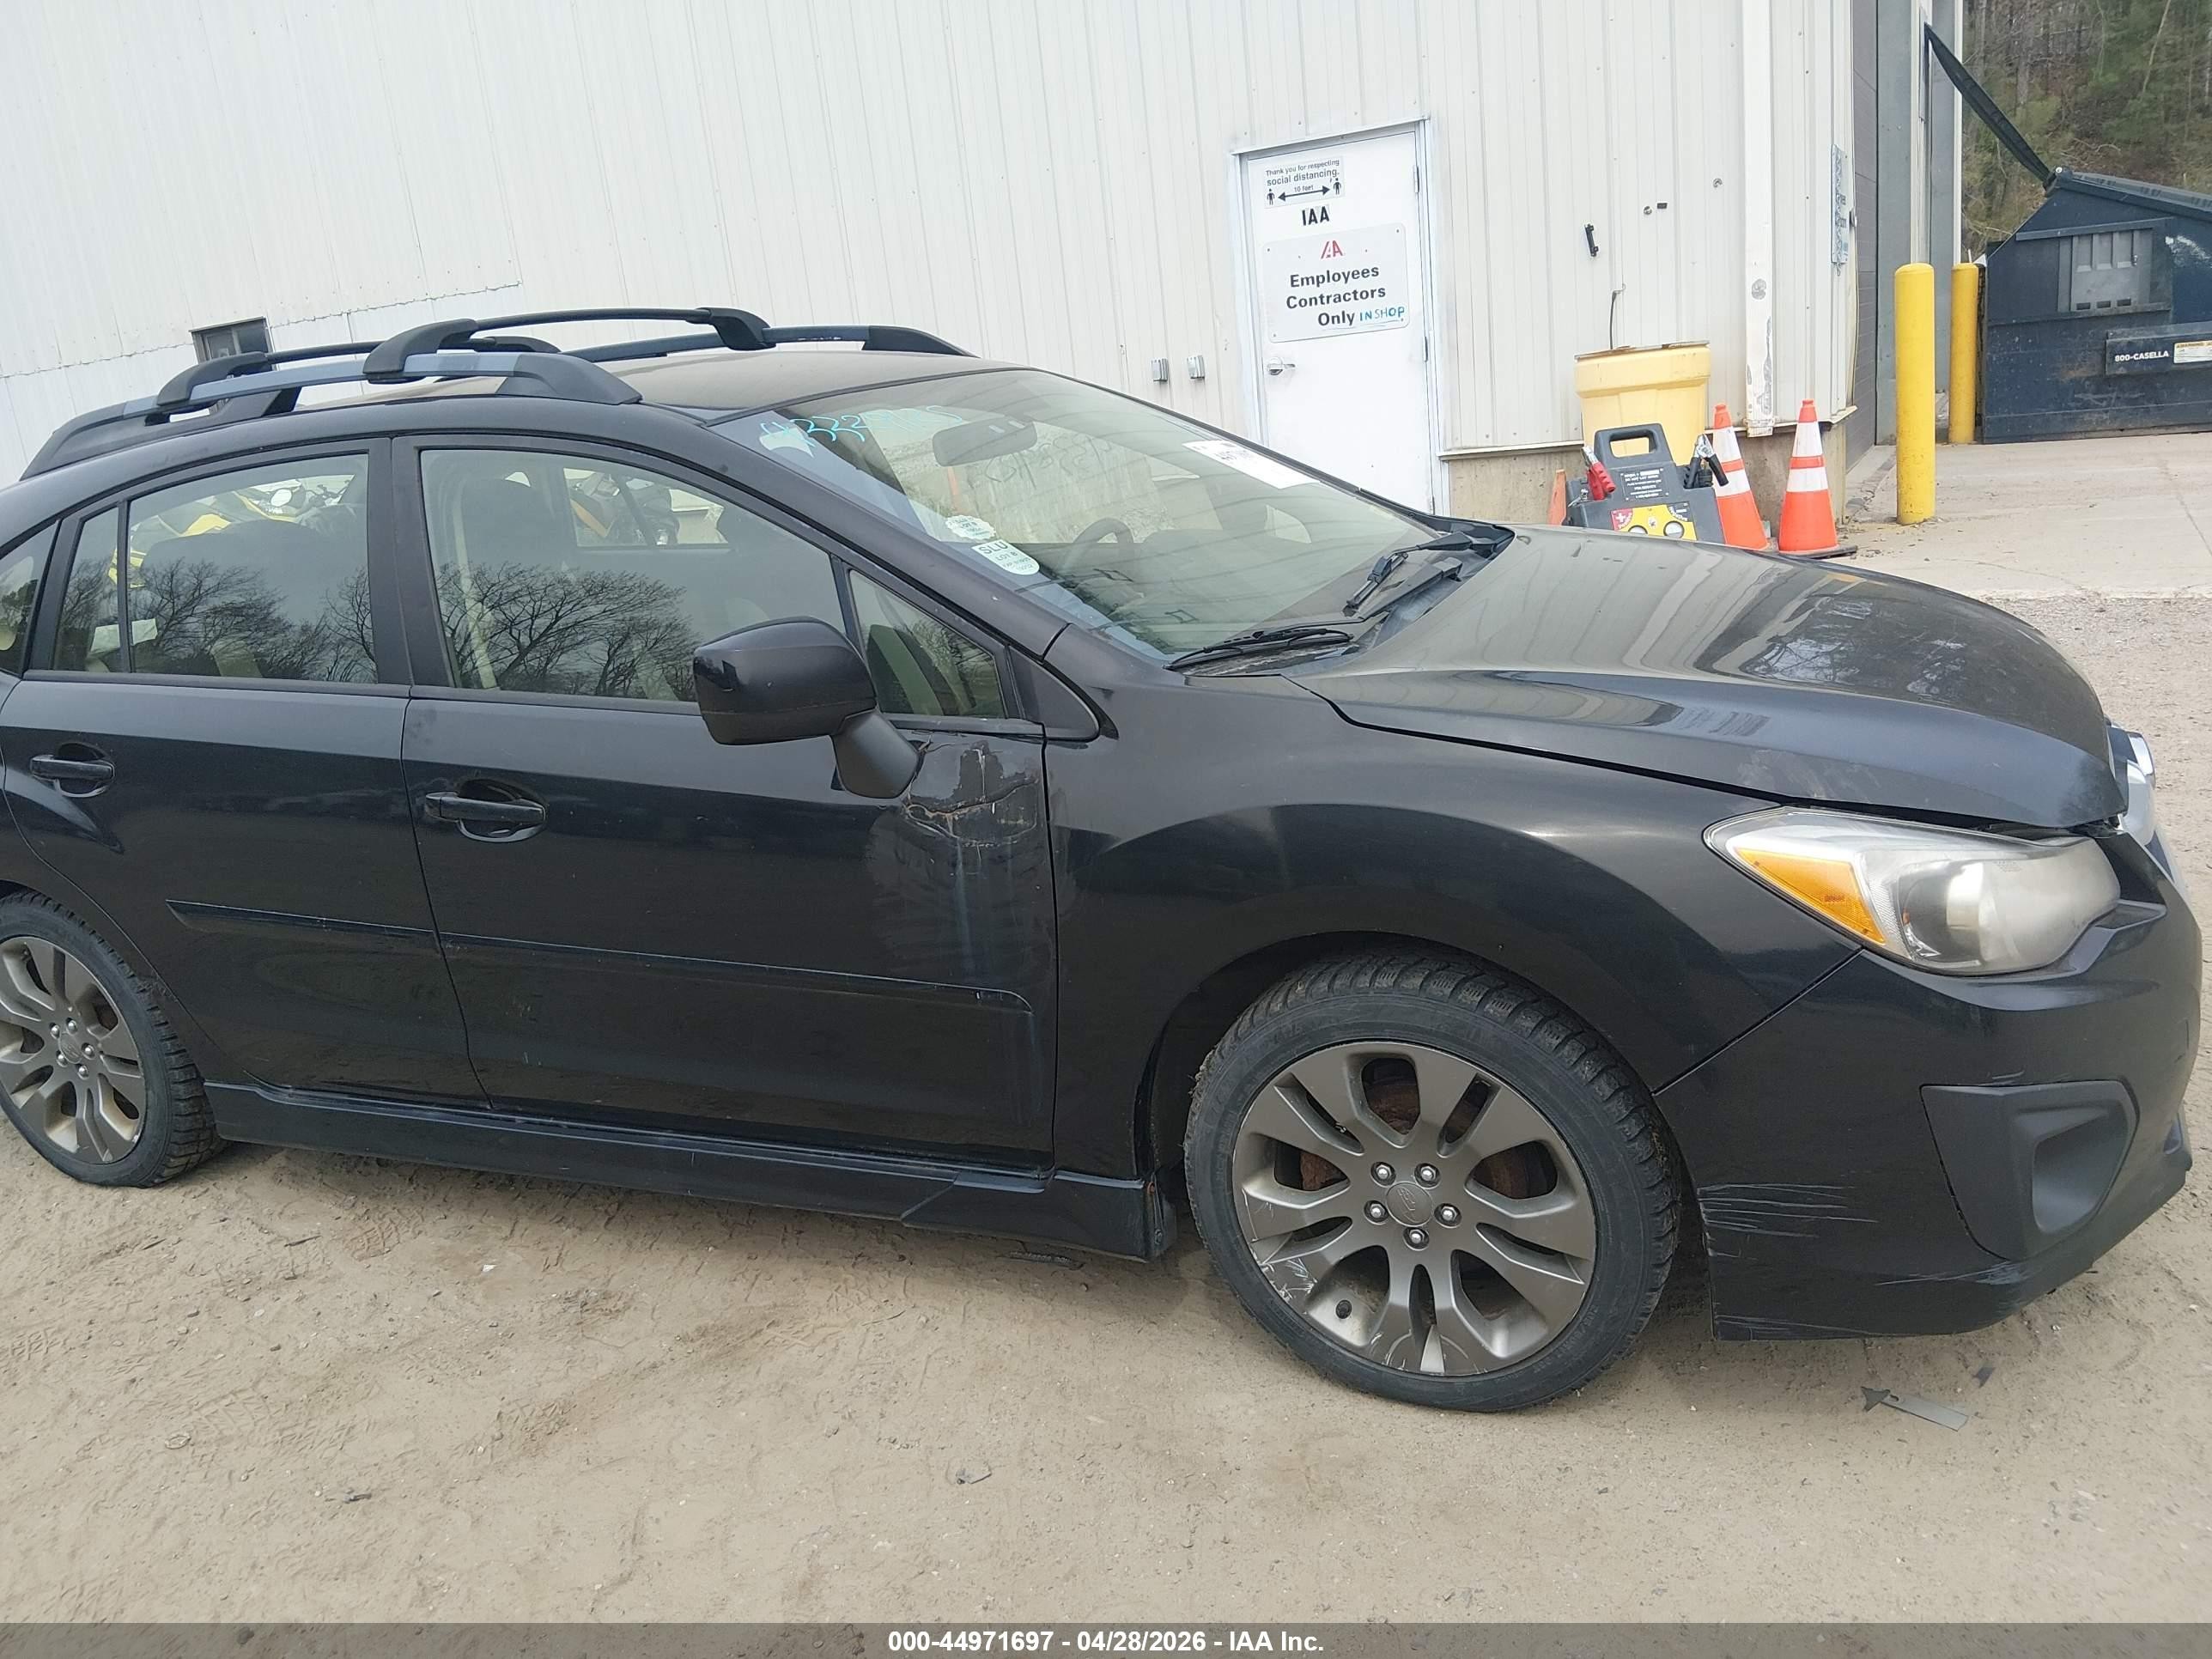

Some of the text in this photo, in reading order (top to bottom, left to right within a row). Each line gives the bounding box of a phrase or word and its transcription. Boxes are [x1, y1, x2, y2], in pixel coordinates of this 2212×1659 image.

[1266, 168, 1285, 177] Thank
[1285, 167, 1297, 175] you
[1308, 159, 1340, 170] respecting
[1267, 174, 1291, 186] social
[1302, 205, 1330, 227] IAA
[1290, 266, 1380, 288] Employees
[1286, 287, 1386, 309] Contractors
[1317, 310, 1355, 326] Only
[2114, 350, 2170, 362] 800-CASELLA
[979, 541, 1008, 555] SLU
